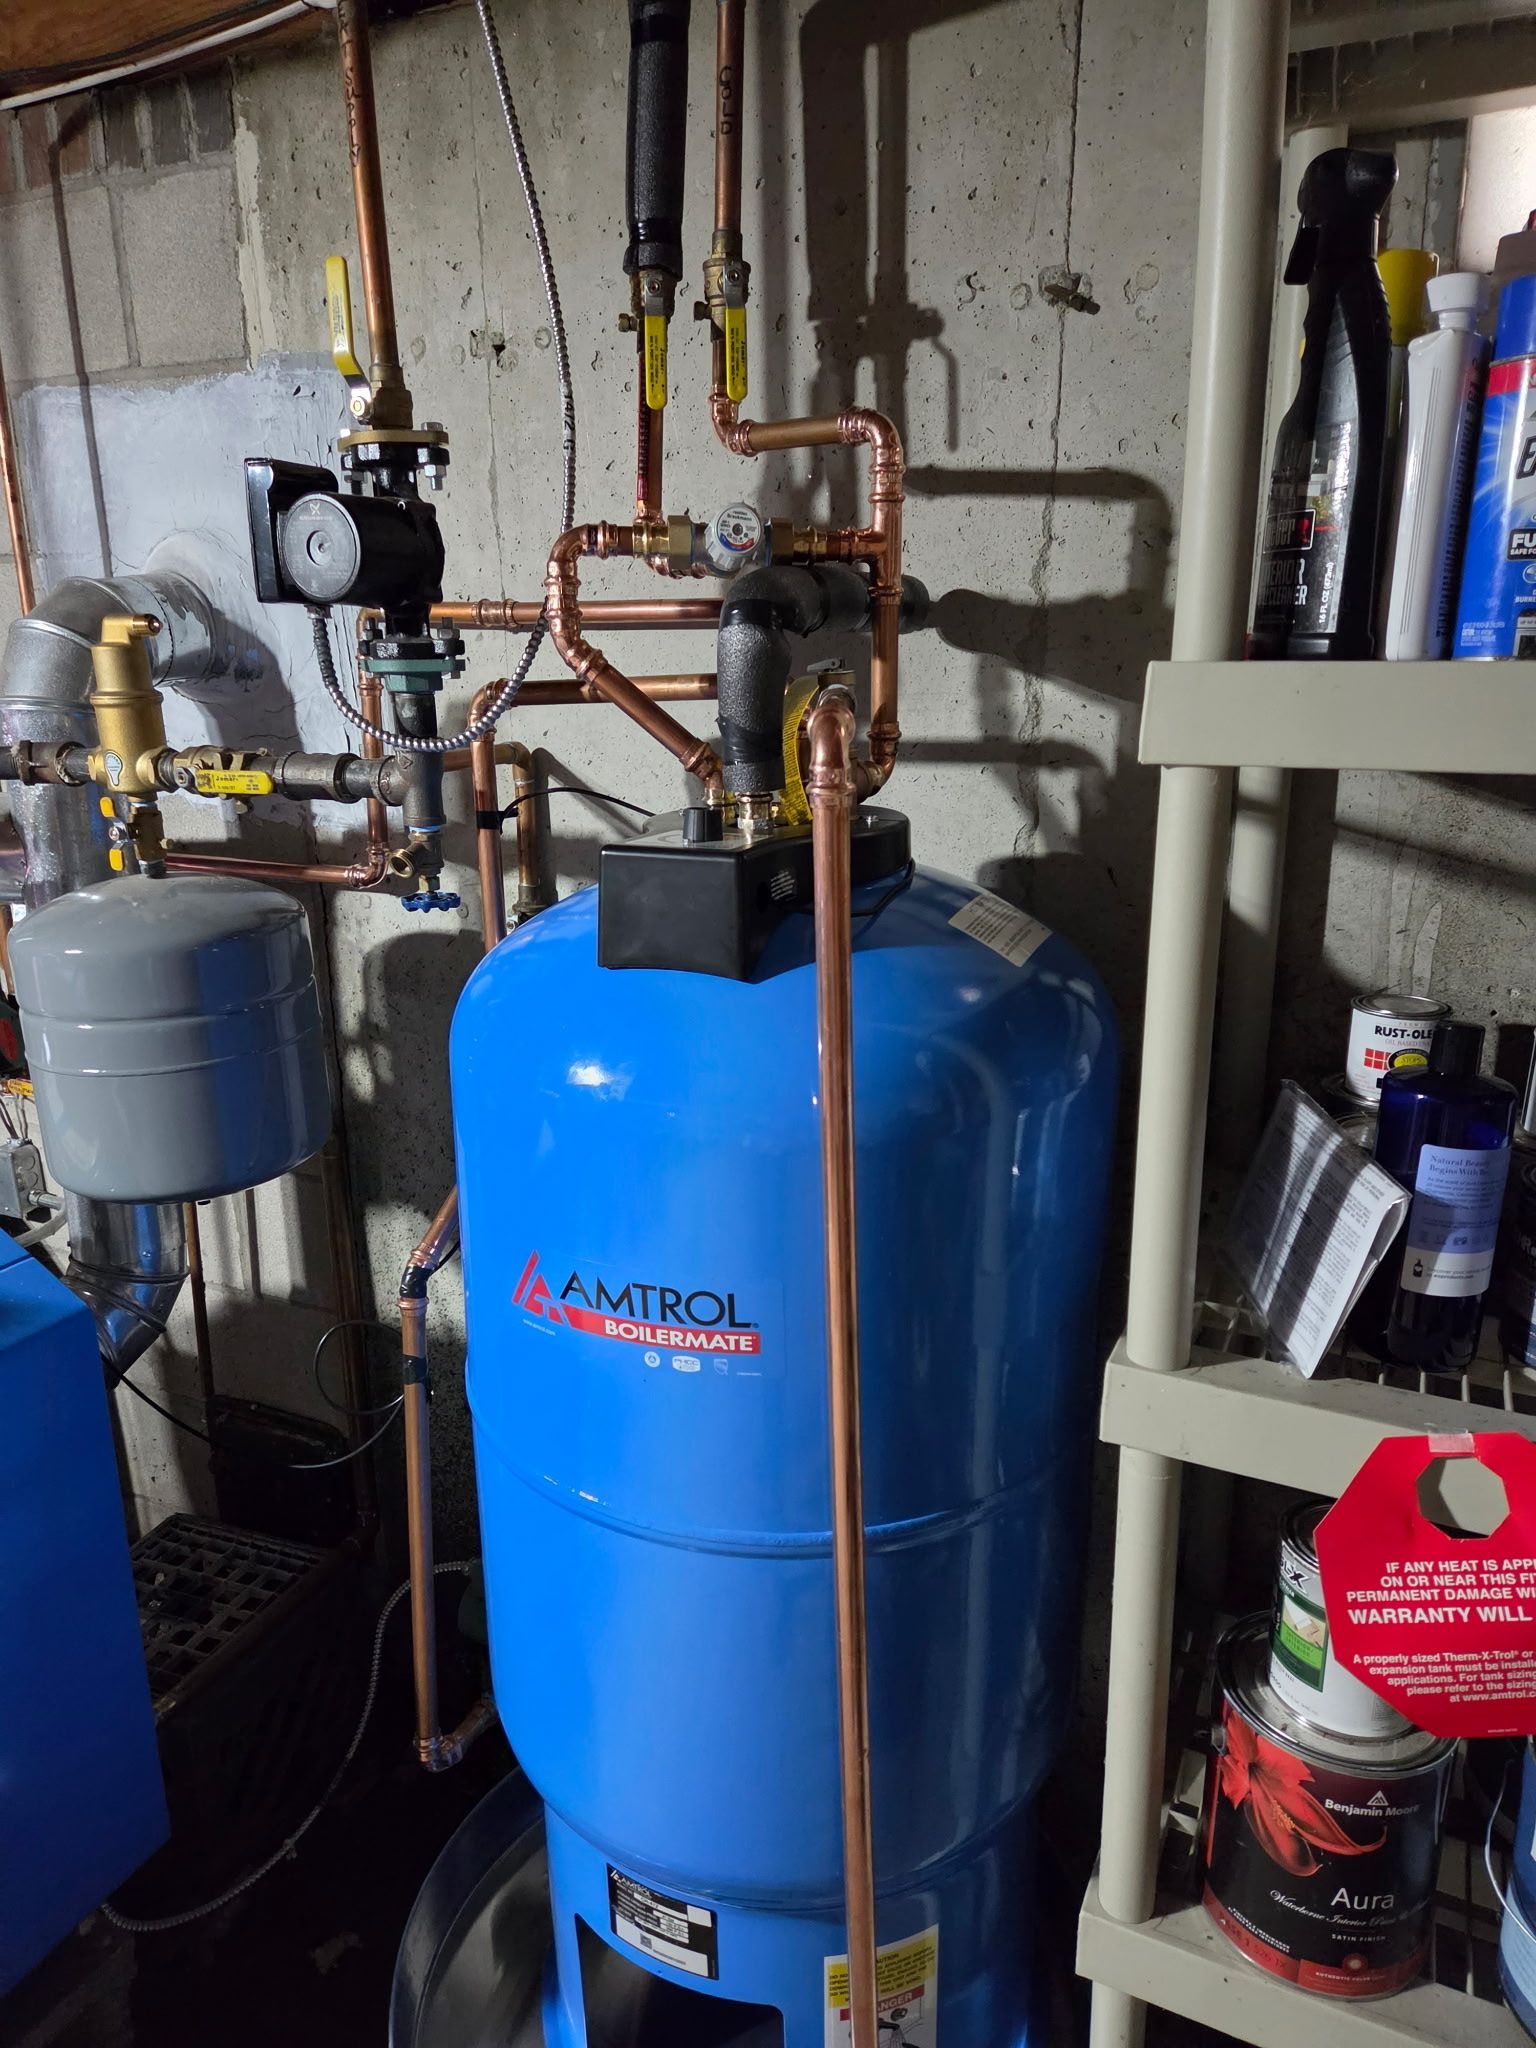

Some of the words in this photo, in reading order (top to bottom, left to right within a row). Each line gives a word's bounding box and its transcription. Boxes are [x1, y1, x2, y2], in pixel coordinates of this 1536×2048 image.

[719, 65, 734, 135] COLD
[564, 394, 576, 431] 14/2
[1321, 589, 1330, 603] OZ
[1320, 603, 1329, 613] FL
[1431, 1154, 1463, 1166] Natural
[1429, 1164, 1458, 1176] Begins
[560, 1271, 752, 1329] AMTROL
[604, 1319, 753, 1352] BOILERMATE
[1386, 1562, 1400, 1573] IF
[1404, 1561, 1434, 1573] ANY
[1438, 1560, 1479, 1572] HEAT
[1483, 1559, 1498, 1571] IS
[1380, 1576, 1403, 1587] ON
[1407, 1575, 1430, 1587] OR
[1433, 1574, 1477, 1586] NEAR
[1480, 1573, 1516, 1585] THIS
[1346, 1588, 1440, 1602] PERMANENT
[1444, 1587, 1513, 1600] DAMAGE
[1516, 1586, 1536, 1599] WI
[1348, 1606, 1471, 1625] WARRANTY
[1476, 1605, 1533, 1622] WILL
[1353, 1654, 1362, 1664] A
[1363, 1653, 1409, 1665] properly
[1411, 1652, 1441, 1663] sized
[1521, 1650, 1533, 1658] or
[1369, 1664, 1426, 1676] expansion
[1428, 1664, 1451, 1673] tank
[1454, 1663, 1482, 1672] must
[1484, 1661, 1499, 1671] be
[1387, 1674, 1457, 1687] applications.
[1459, 1672, 1478, 1683] For
[1480, 1671, 1504, 1680] tank
[1406, 1686, 1443, 1697] please
[1444, 1684, 1470, 1694] refer
[1472, 1683, 1484, 1692] to
[1486, 1681, 1504, 1690] the
[1450, 1694, 1461, 1703] at
[1463, 1690, 1536, 1702] www.amtrol.c
[1325, 1799, 1382, 1816] Benjamin
[1331, 1888, 1394, 1910] Aura
[1270, 1889, 1325, 1920] Waterborne
[1326, 1913, 1367, 1927] Interior
[1331, 1933, 1357, 1942] SATIN
[879, 1992, 913, 2011] NGER
